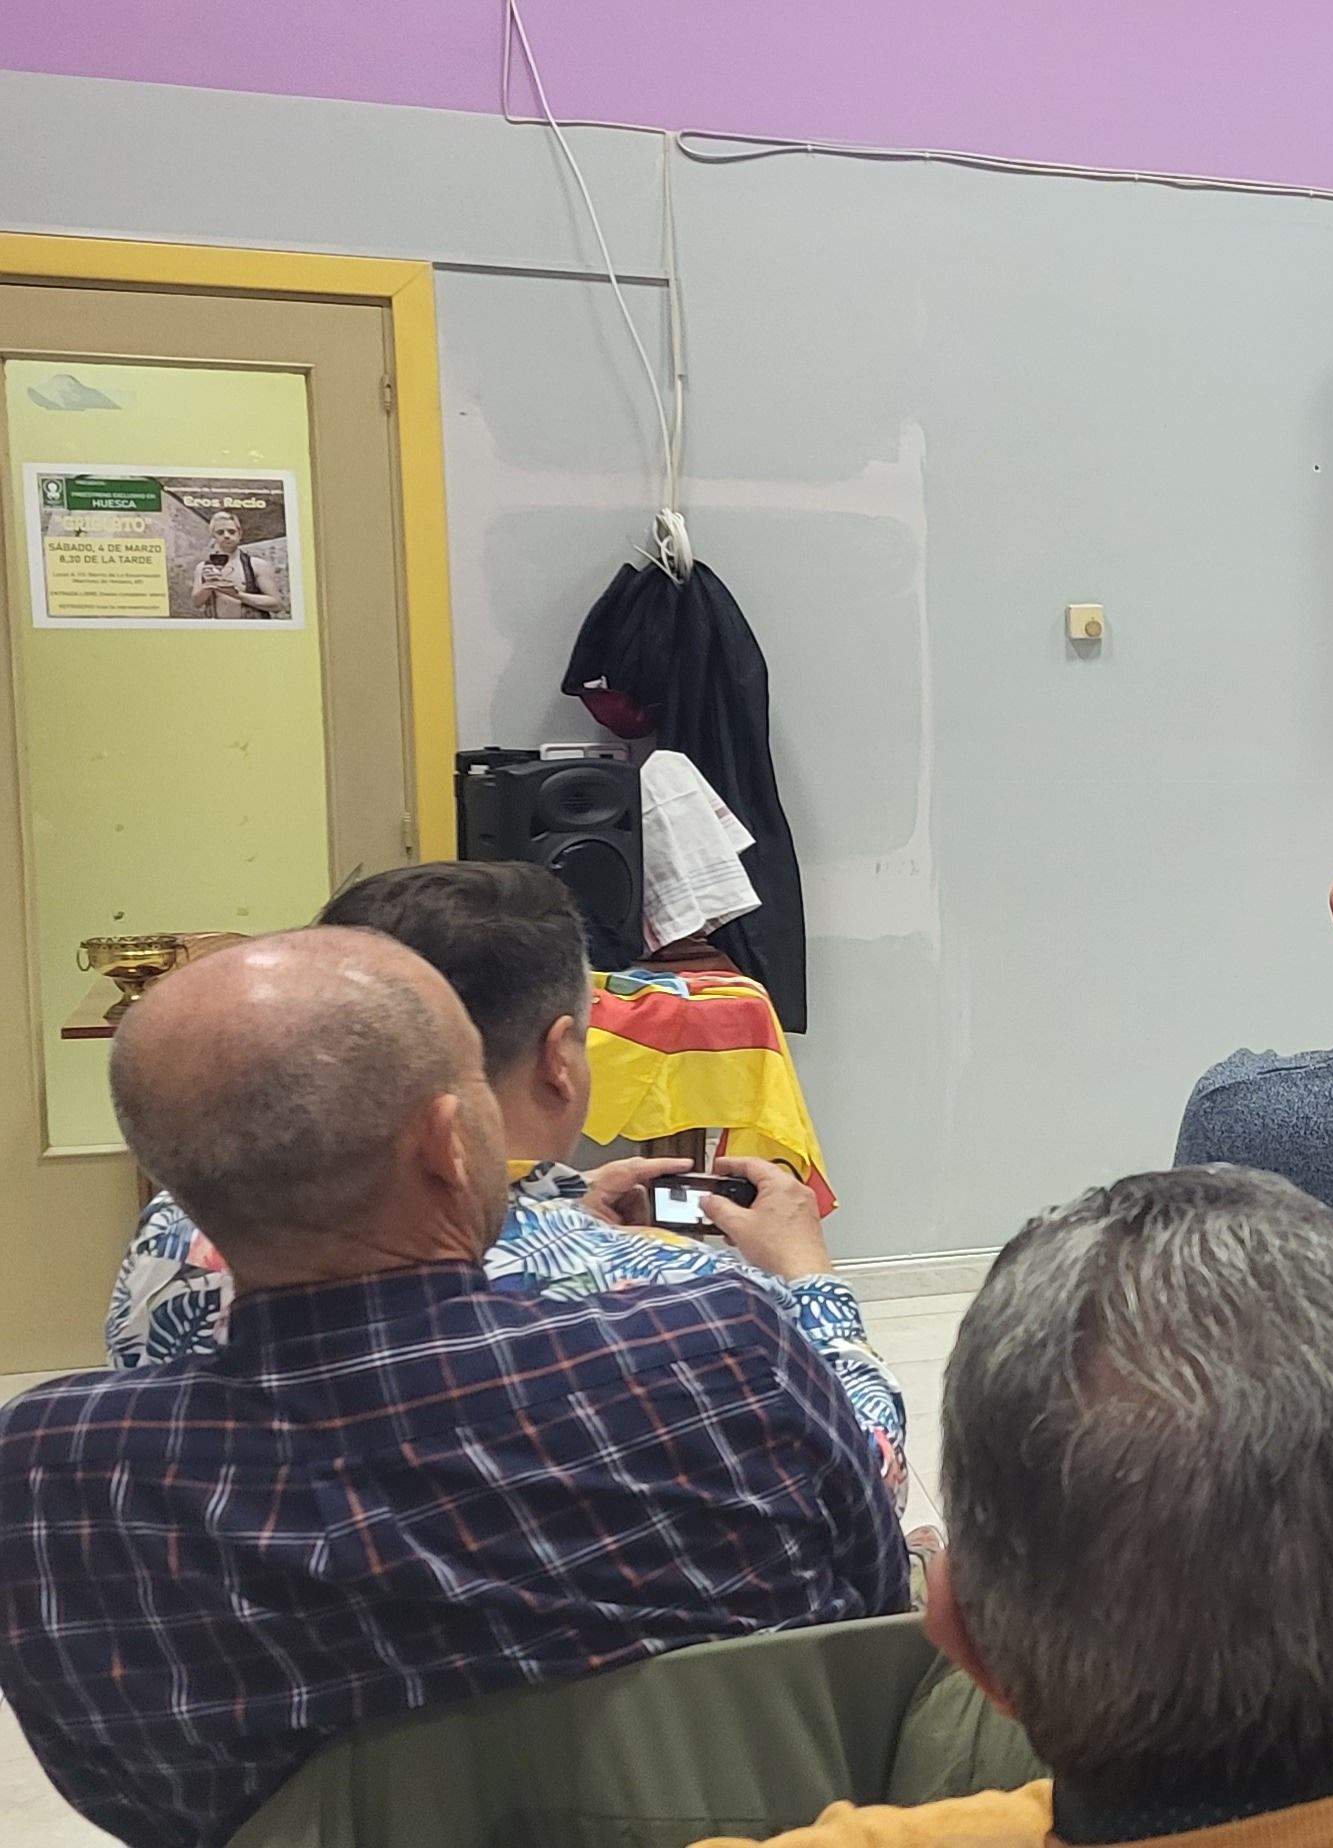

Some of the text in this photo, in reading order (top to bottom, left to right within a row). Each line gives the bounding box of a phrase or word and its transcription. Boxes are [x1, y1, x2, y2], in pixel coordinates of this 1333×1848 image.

[91, 499, 137, 509] HUESCA
[182, 495, 221, 507] Eros
[98, 543, 105, 552] 4
[107, 543, 121, 552] DE
[125, 544, 162, 553] MARZO
[84, 555, 98, 564] DE
[101, 556, 116, 564] LA
[118, 556, 153, 565] TARDE
